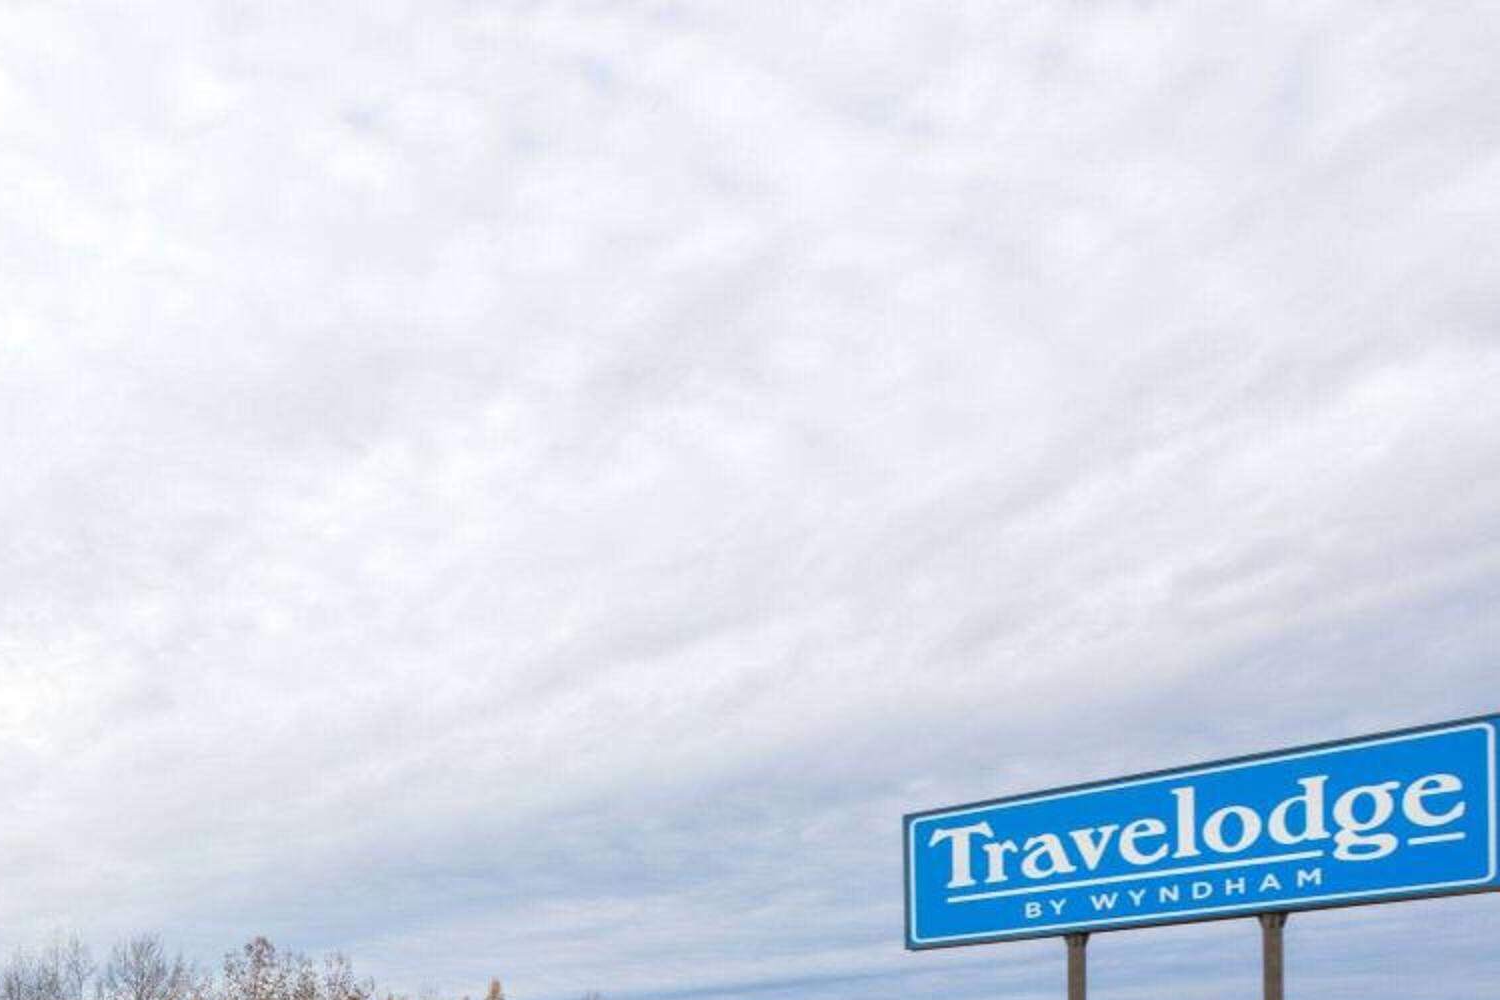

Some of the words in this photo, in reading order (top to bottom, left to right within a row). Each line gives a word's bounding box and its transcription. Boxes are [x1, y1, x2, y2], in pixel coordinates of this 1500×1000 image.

[929, 772, 1466, 889] Travelodge
[1025, 899, 1068, 920] BY
[1091, 867, 1324, 912] WYNDHAM
